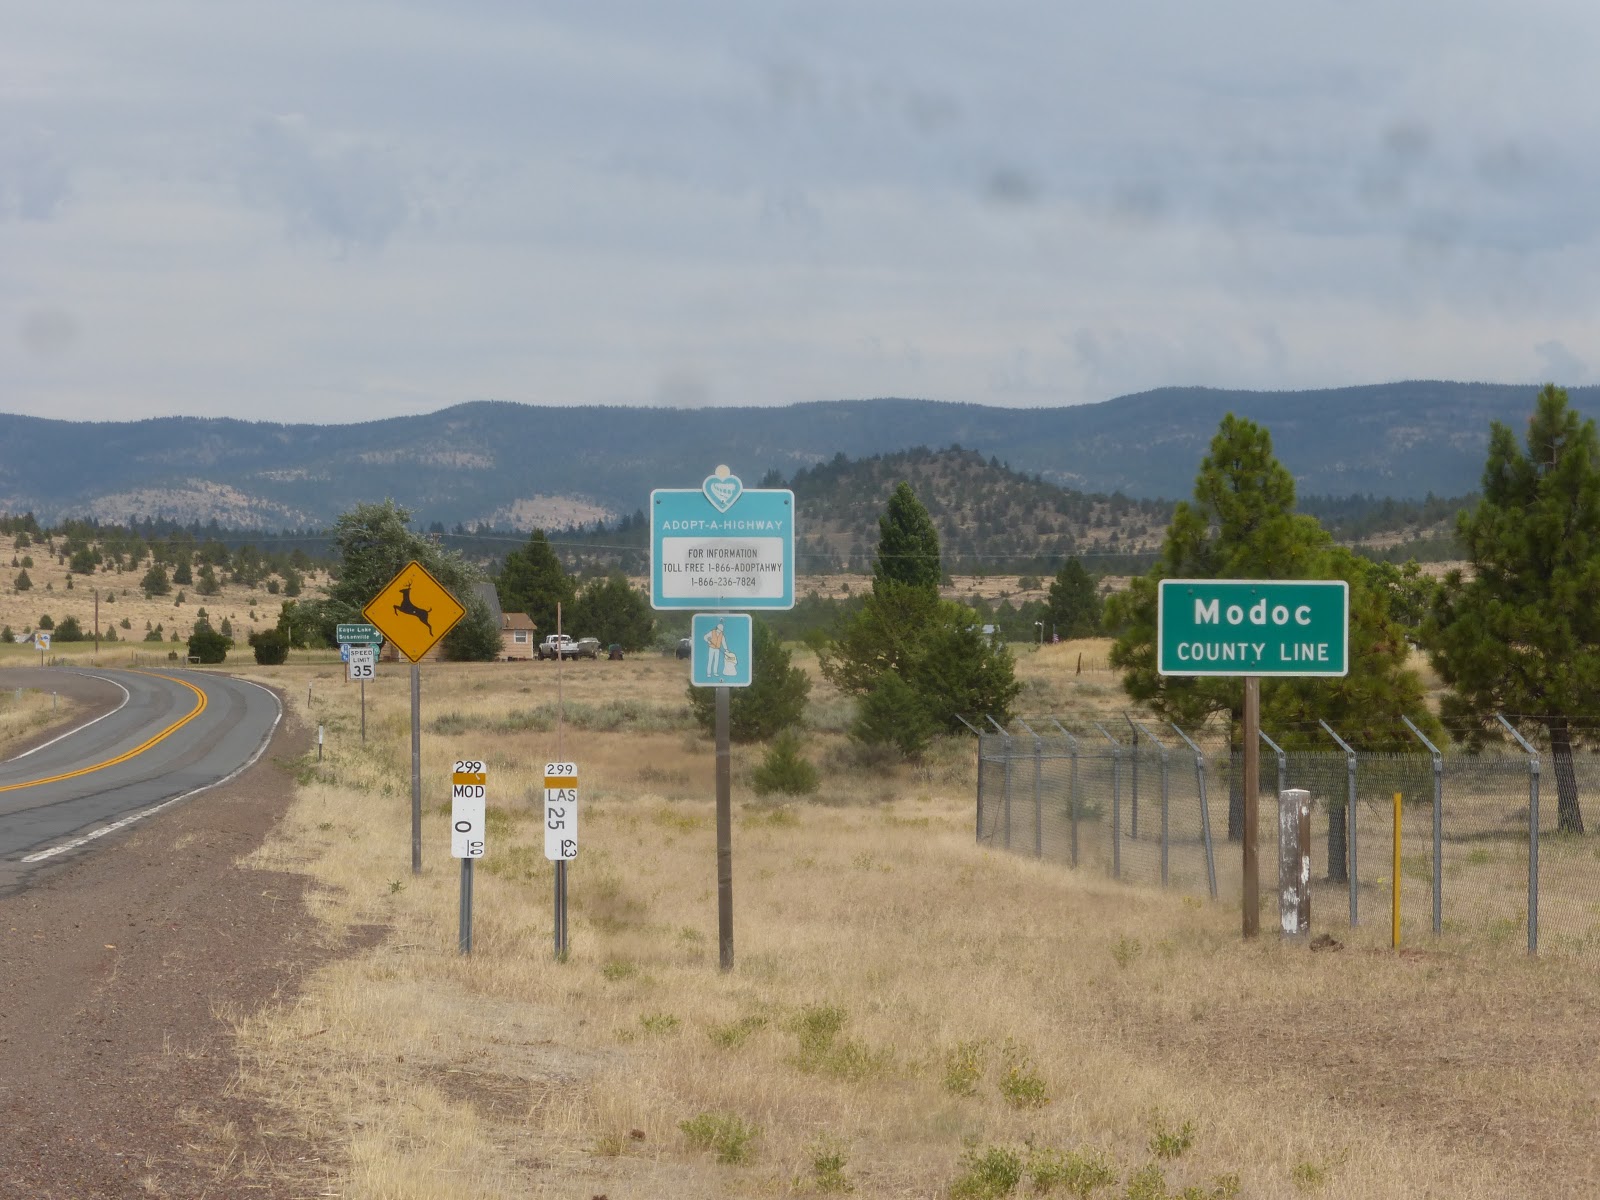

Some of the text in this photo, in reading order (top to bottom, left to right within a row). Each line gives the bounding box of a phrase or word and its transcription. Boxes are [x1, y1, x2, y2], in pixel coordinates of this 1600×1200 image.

[662, 520, 783, 530] ADOPT-A-HIGHWAY
[688, 549, 758, 558] FOR INFORMATION
[663, 563, 782, 573] TOLL FREE 1-866-ADOPTAHWY
[691, 577, 756, 587] 1-866-236-7824
[1195, 598, 1312, 625] Modoc
[1177, 642, 1329, 661] COUNTY LINE
[354, 665, 372, 677] 35
[455, 760, 482, 774] 299
[547, 764, 573, 775] 299
[453, 785, 484, 798] MOD
[547, 789, 576, 802] LAS
[547, 807, 565, 830] 25
